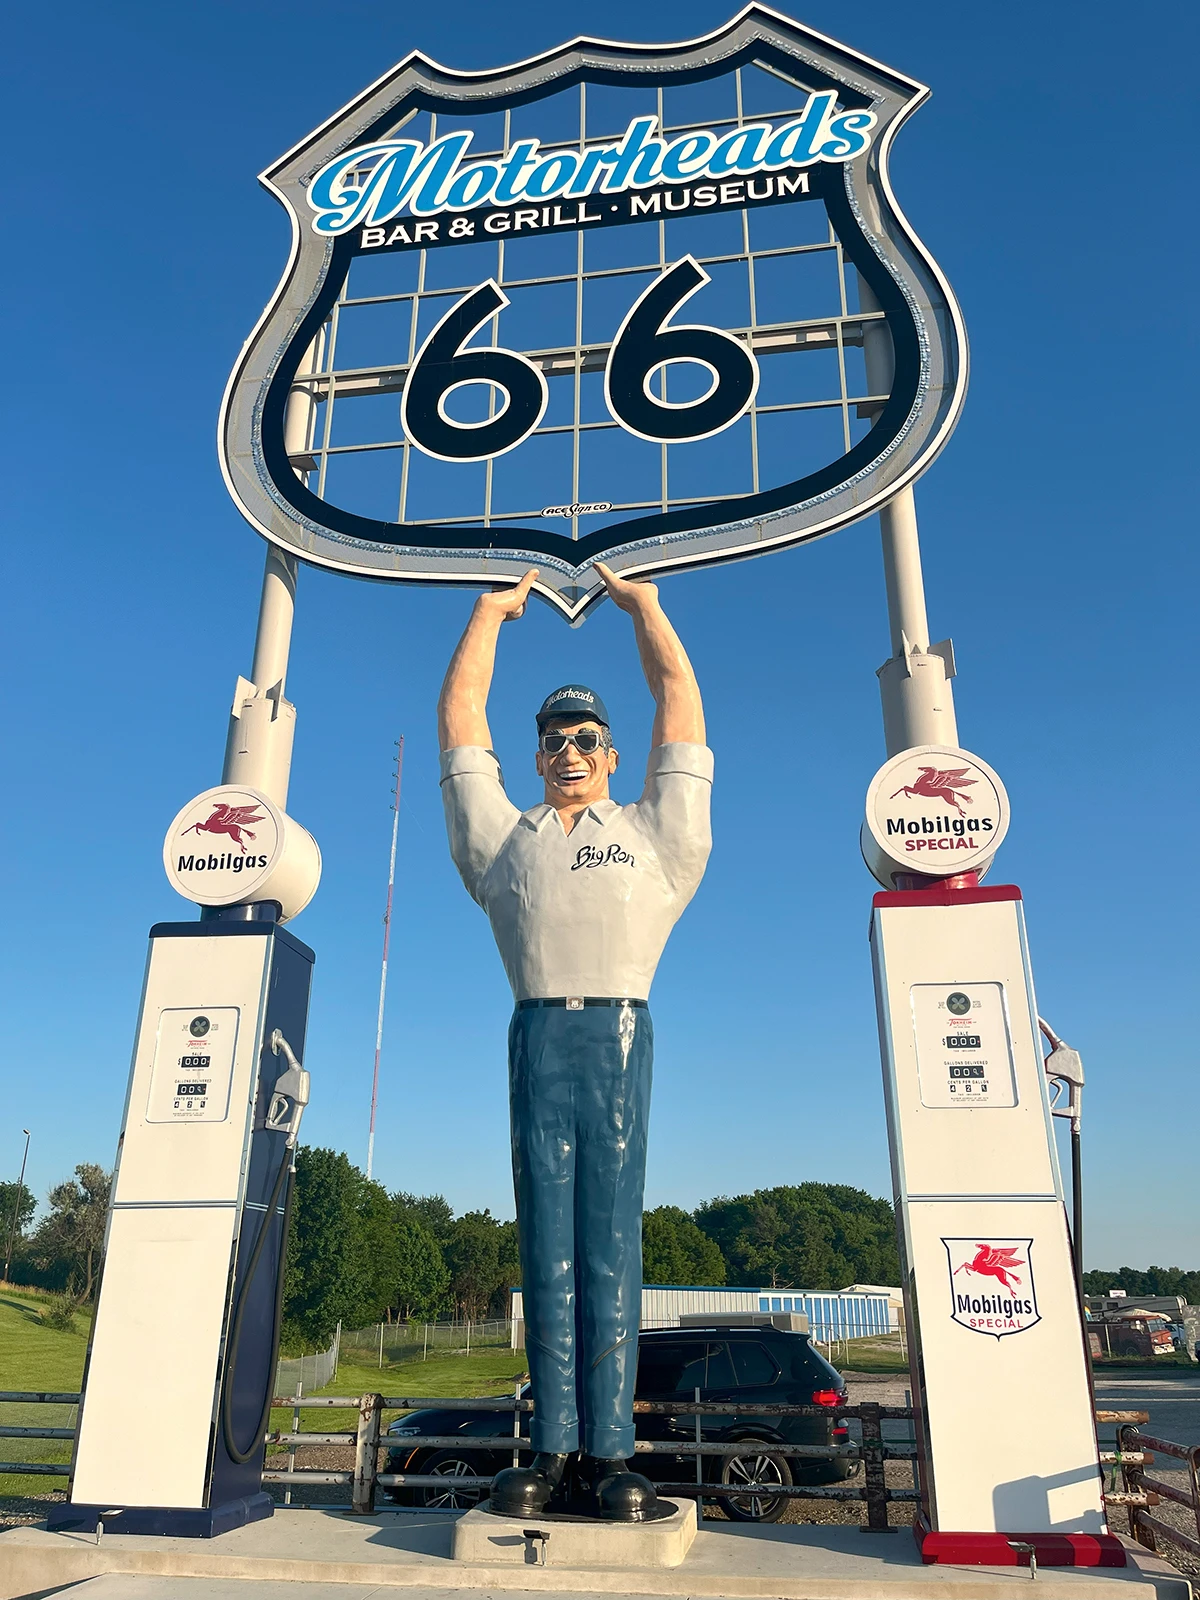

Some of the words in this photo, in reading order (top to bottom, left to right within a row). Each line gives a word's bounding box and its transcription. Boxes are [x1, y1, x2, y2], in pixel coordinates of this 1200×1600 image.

[307, 89, 878, 237] Motorheads
[360, 222, 439, 248] BAR
[449, 217, 475, 238] &
[484, 202, 602, 233] GRILL
[629, 173, 810, 216] MUSEUM
[563, 503, 592, 518] Sign
[546, 687, 595, 709] Motorheads
[887, 816, 993, 836] Mobilgas
[905, 837, 979, 851] SPECIAL
[178, 853, 268, 873] Mobilgas
[570, 845, 604, 871] Big
[603, 843, 635, 868] Ron
[957, 1294, 1032, 1319] Mobilgas
[970, 1318, 1024, 1328] SPECIAL
